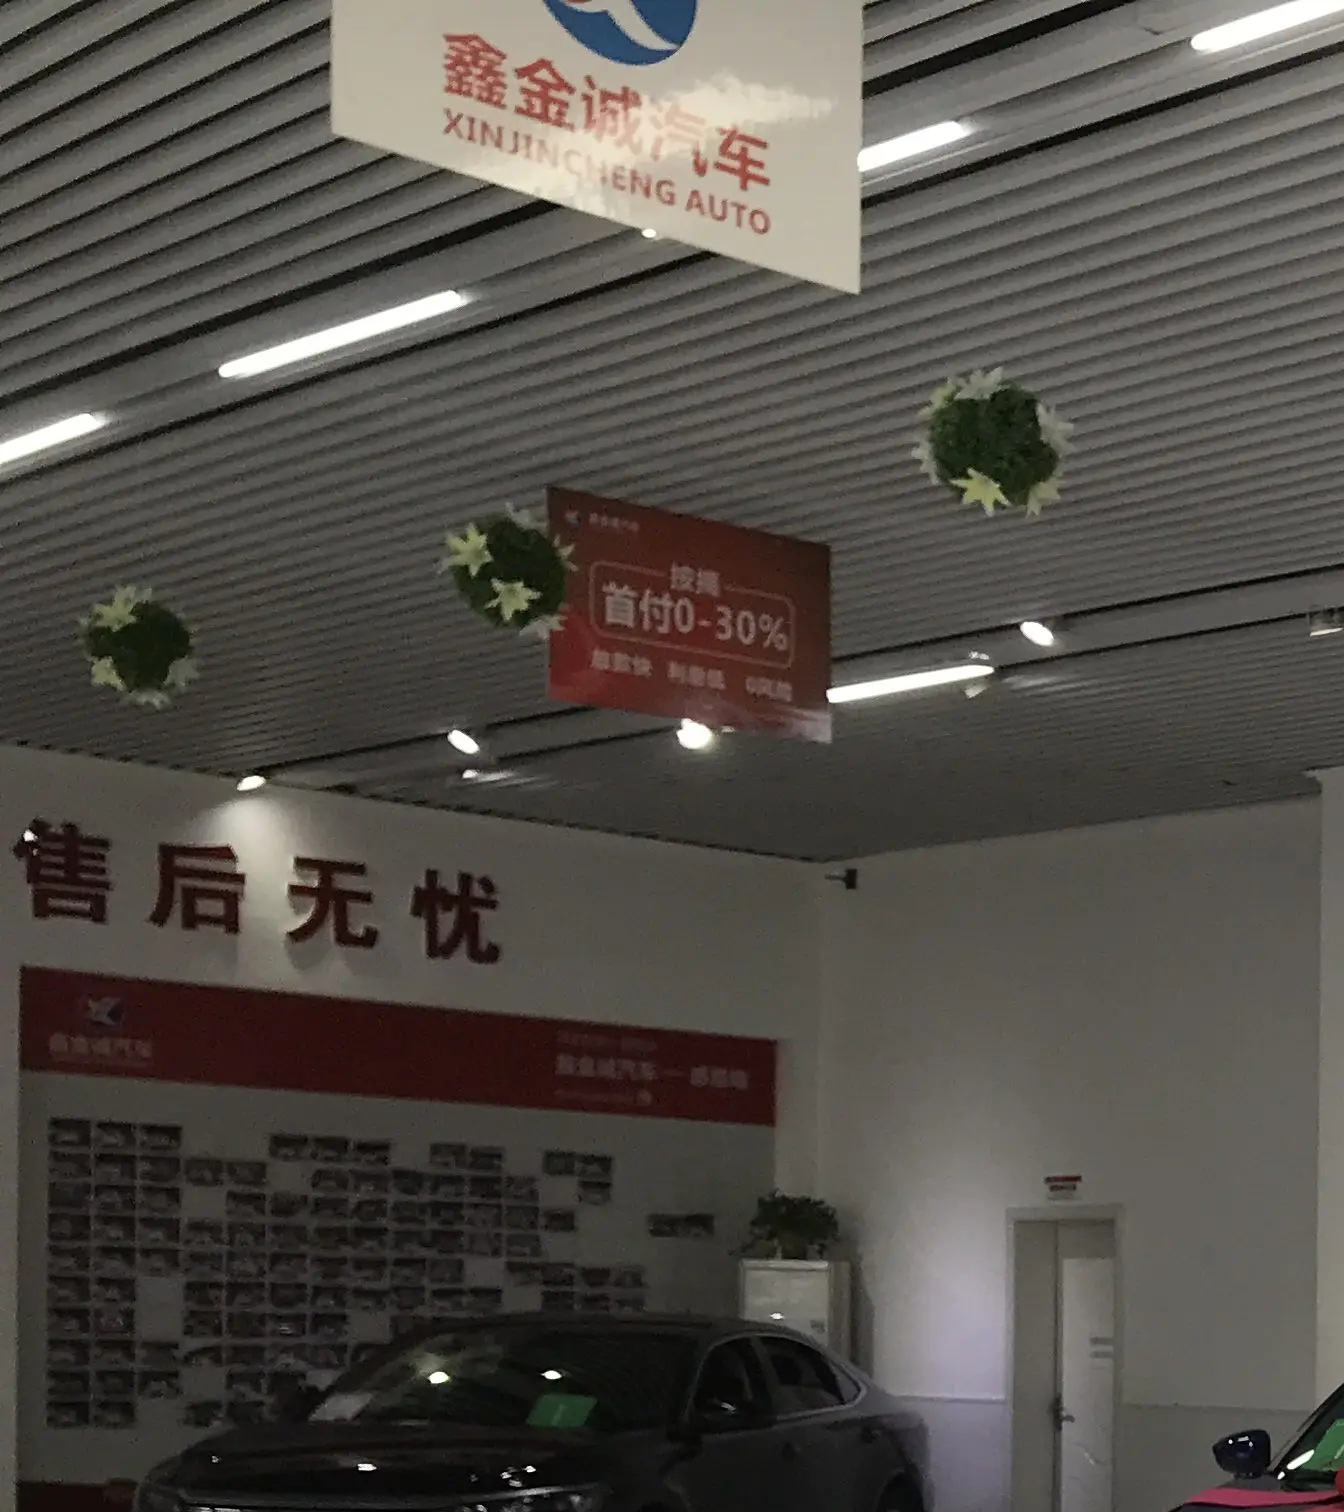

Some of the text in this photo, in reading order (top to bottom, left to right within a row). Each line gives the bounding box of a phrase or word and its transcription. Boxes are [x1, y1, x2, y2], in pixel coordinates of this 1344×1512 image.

[442, 32, 771, 192] 鑫金诚汽车
[442, 107, 771, 235] XINJINCHENG AUTO
[602, 580, 788, 652] 首付0-30%
[13, 818, 502, 964] 售后无忧
